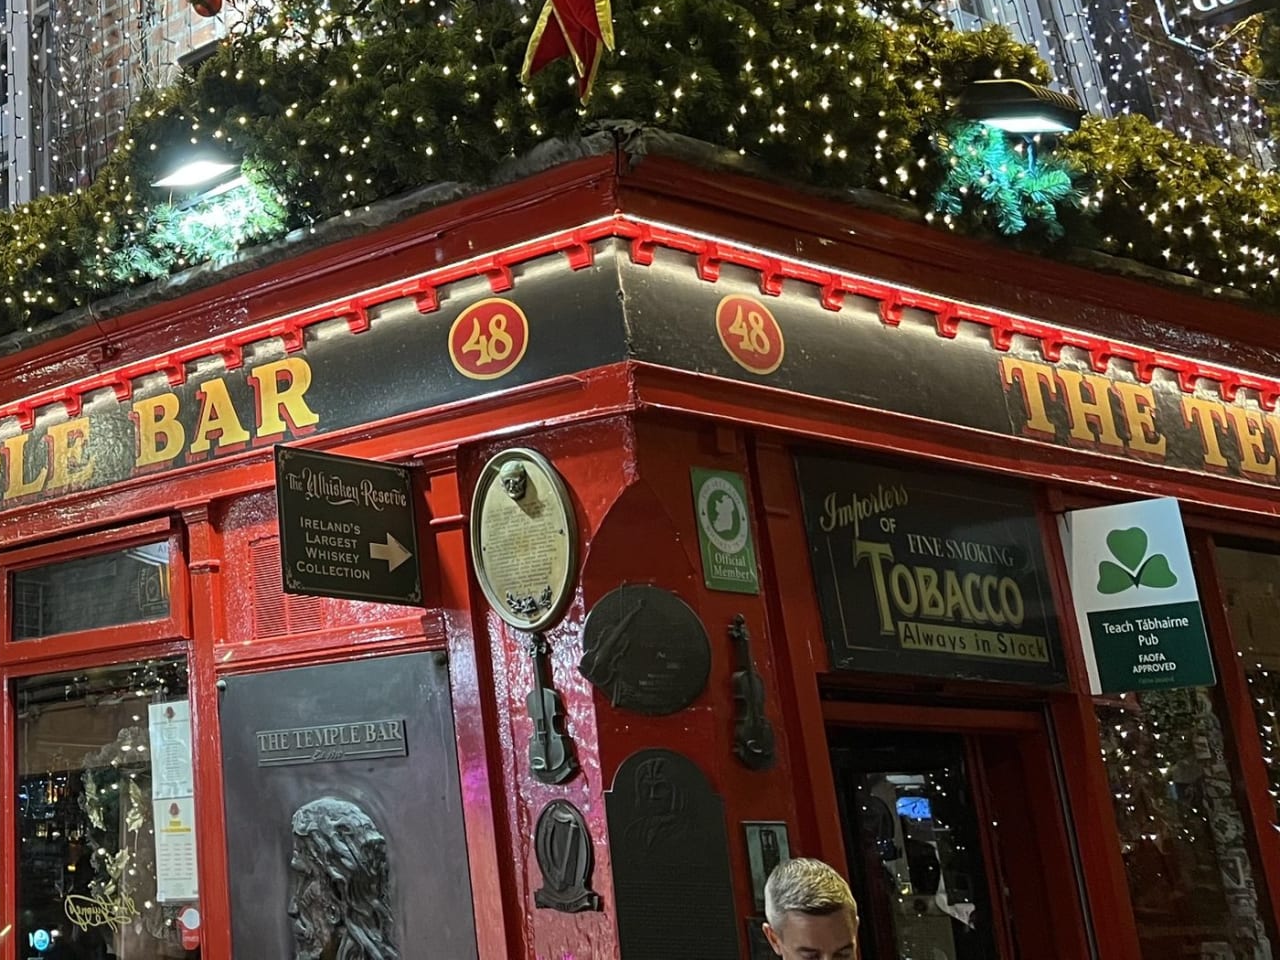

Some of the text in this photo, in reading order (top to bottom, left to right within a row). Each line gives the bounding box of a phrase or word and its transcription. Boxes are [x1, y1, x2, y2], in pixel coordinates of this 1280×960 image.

[728, 304, 770, 354] 48
[461, 313, 513, 366] 48
[132, 356, 320, 467] BAR
[999, 355, 1280, 478] THE TE
[286, 466, 407, 511] The Whiskey Reserve
[820, 483, 909, 538] Importers
[300, 516, 361, 535] IRELAND'S
[880, 517, 897, 534] OF
[305, 531, 358, 549] LARGEST
[907, 533, 1015, 567] FINE SMOKING
[305, 546, 360, 564] WHISKEY
[715, 552, 746, 567] Official
[296, 560, 371, 580] COLLECTION
[713, 565, 751, 581] Member
[853, 539, 1026, 636] TOBACCO
[1102, 616, 1190, 634] Teach Tábhairne
[902, 623, 1047, 659] Always in Stock
[1138, 633, 1160, 646] Pub
[1132, 661, 1177, 674] APPROVED
[1138, 652, 1166, 663] FAOFA
[256, 720, 402, 753] THE TEMPLE BAR
